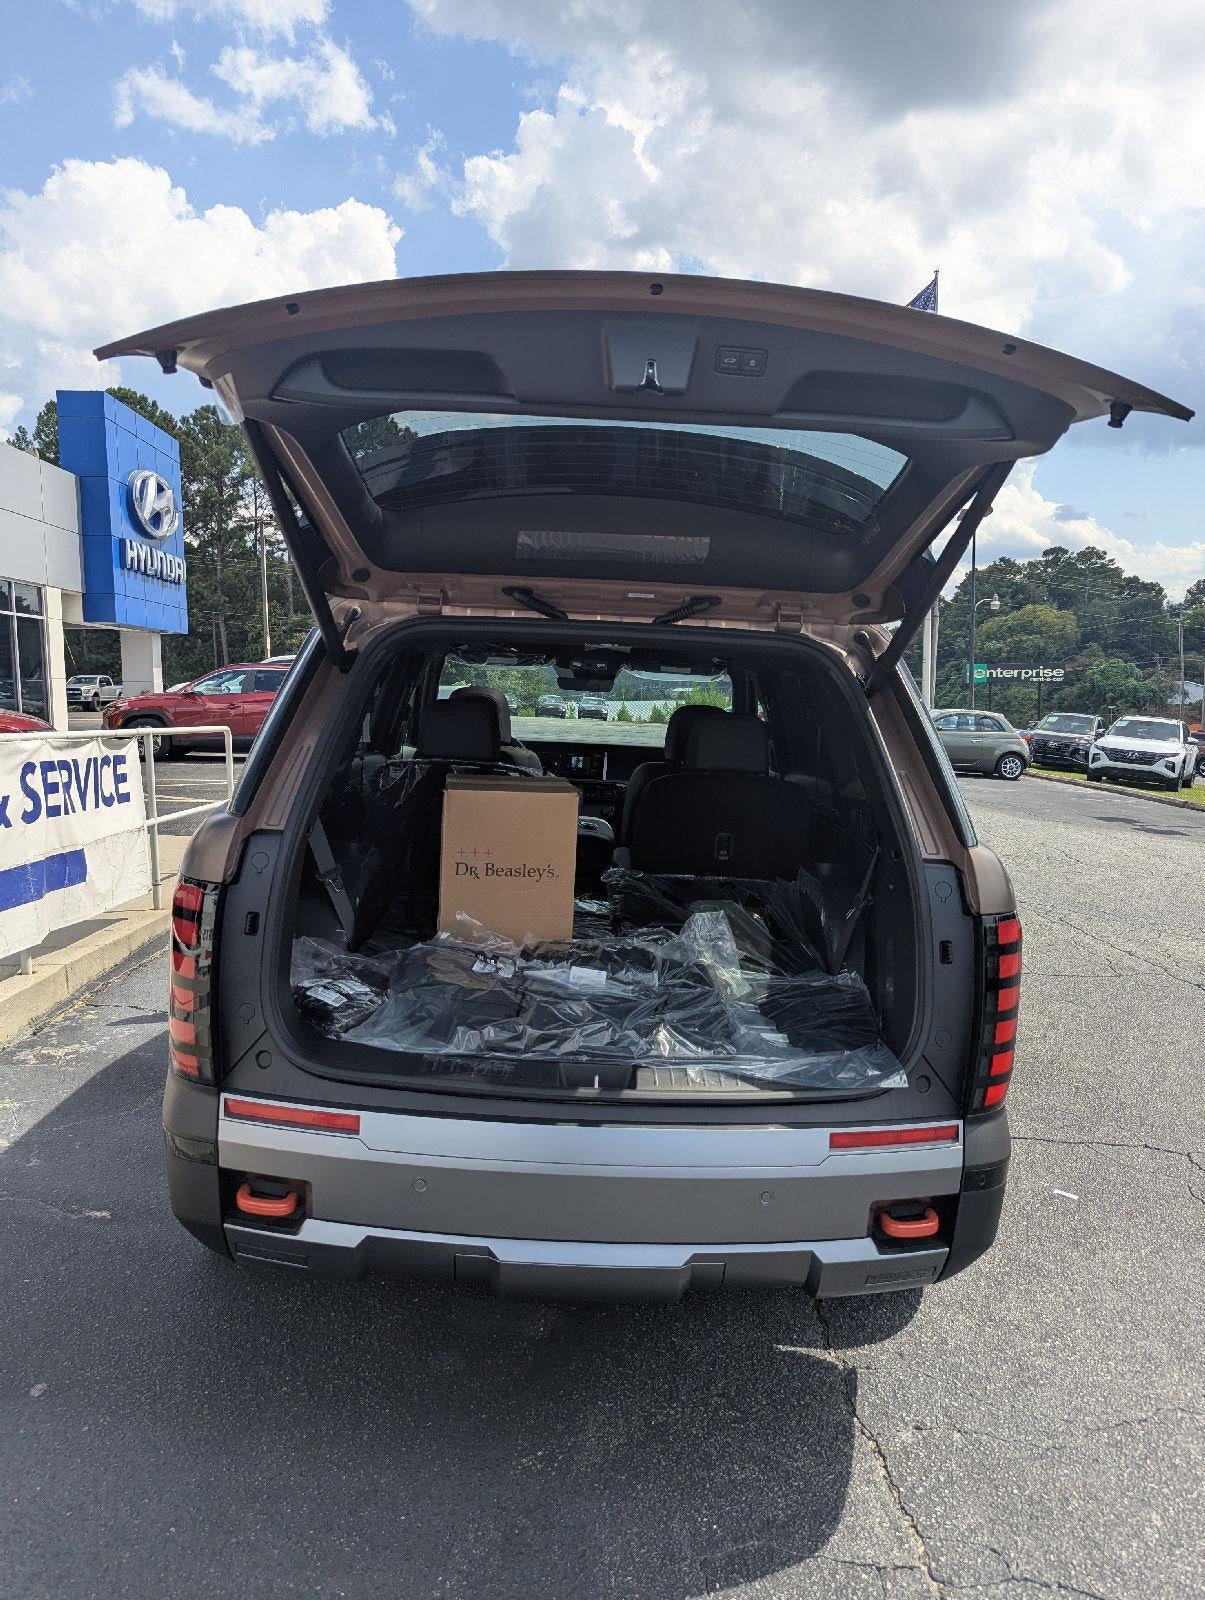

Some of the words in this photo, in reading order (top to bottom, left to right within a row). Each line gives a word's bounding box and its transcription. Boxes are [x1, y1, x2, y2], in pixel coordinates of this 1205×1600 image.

[122, 539, 186, 584] HYUNDAI
[973, 665, 1065, 680] enterprise
[20, 754, 131, 825] SERVICE
